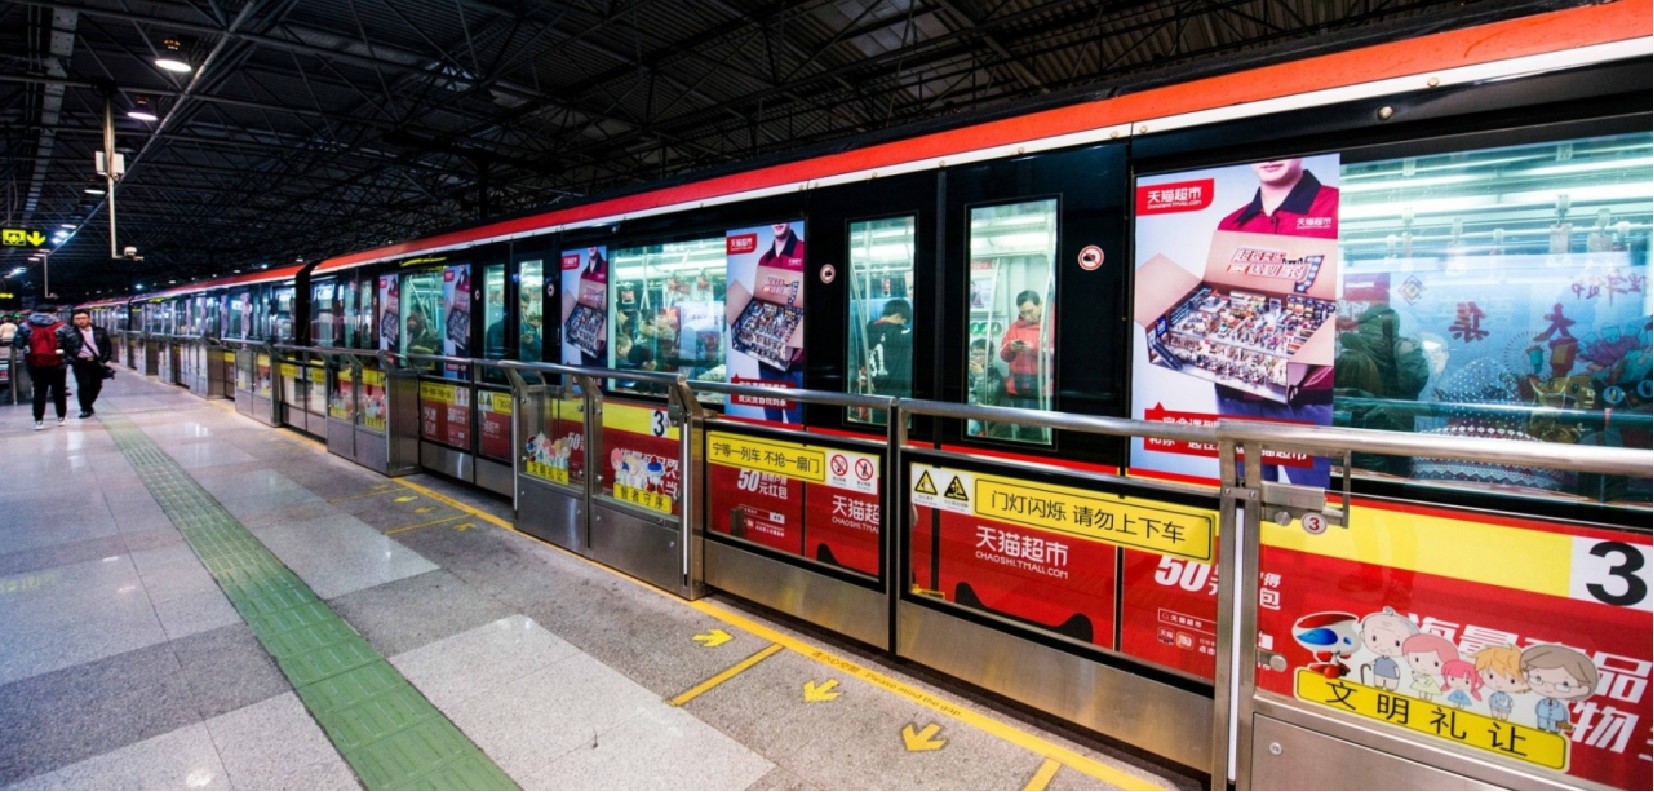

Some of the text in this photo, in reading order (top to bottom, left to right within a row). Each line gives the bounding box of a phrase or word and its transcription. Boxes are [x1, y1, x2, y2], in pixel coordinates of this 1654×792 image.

[654, 410, 665, 437] 3
[764, 450, 820, 474] 不抢一扇门
[737, 468, 760, 492] 50
[759, 481, 788, 499] 元红包
[991, 490, 1187, 544] 门灯闪烁 请勿上下车
[1308, 516, 1320, 531] 3
[975, 525, 1069, 567] 天猫超市
[1155, 556, 1211, 592] 50
[1586, 541, 1648, 606] 3
[1325, 681, 1528, 757] 文明礼让
